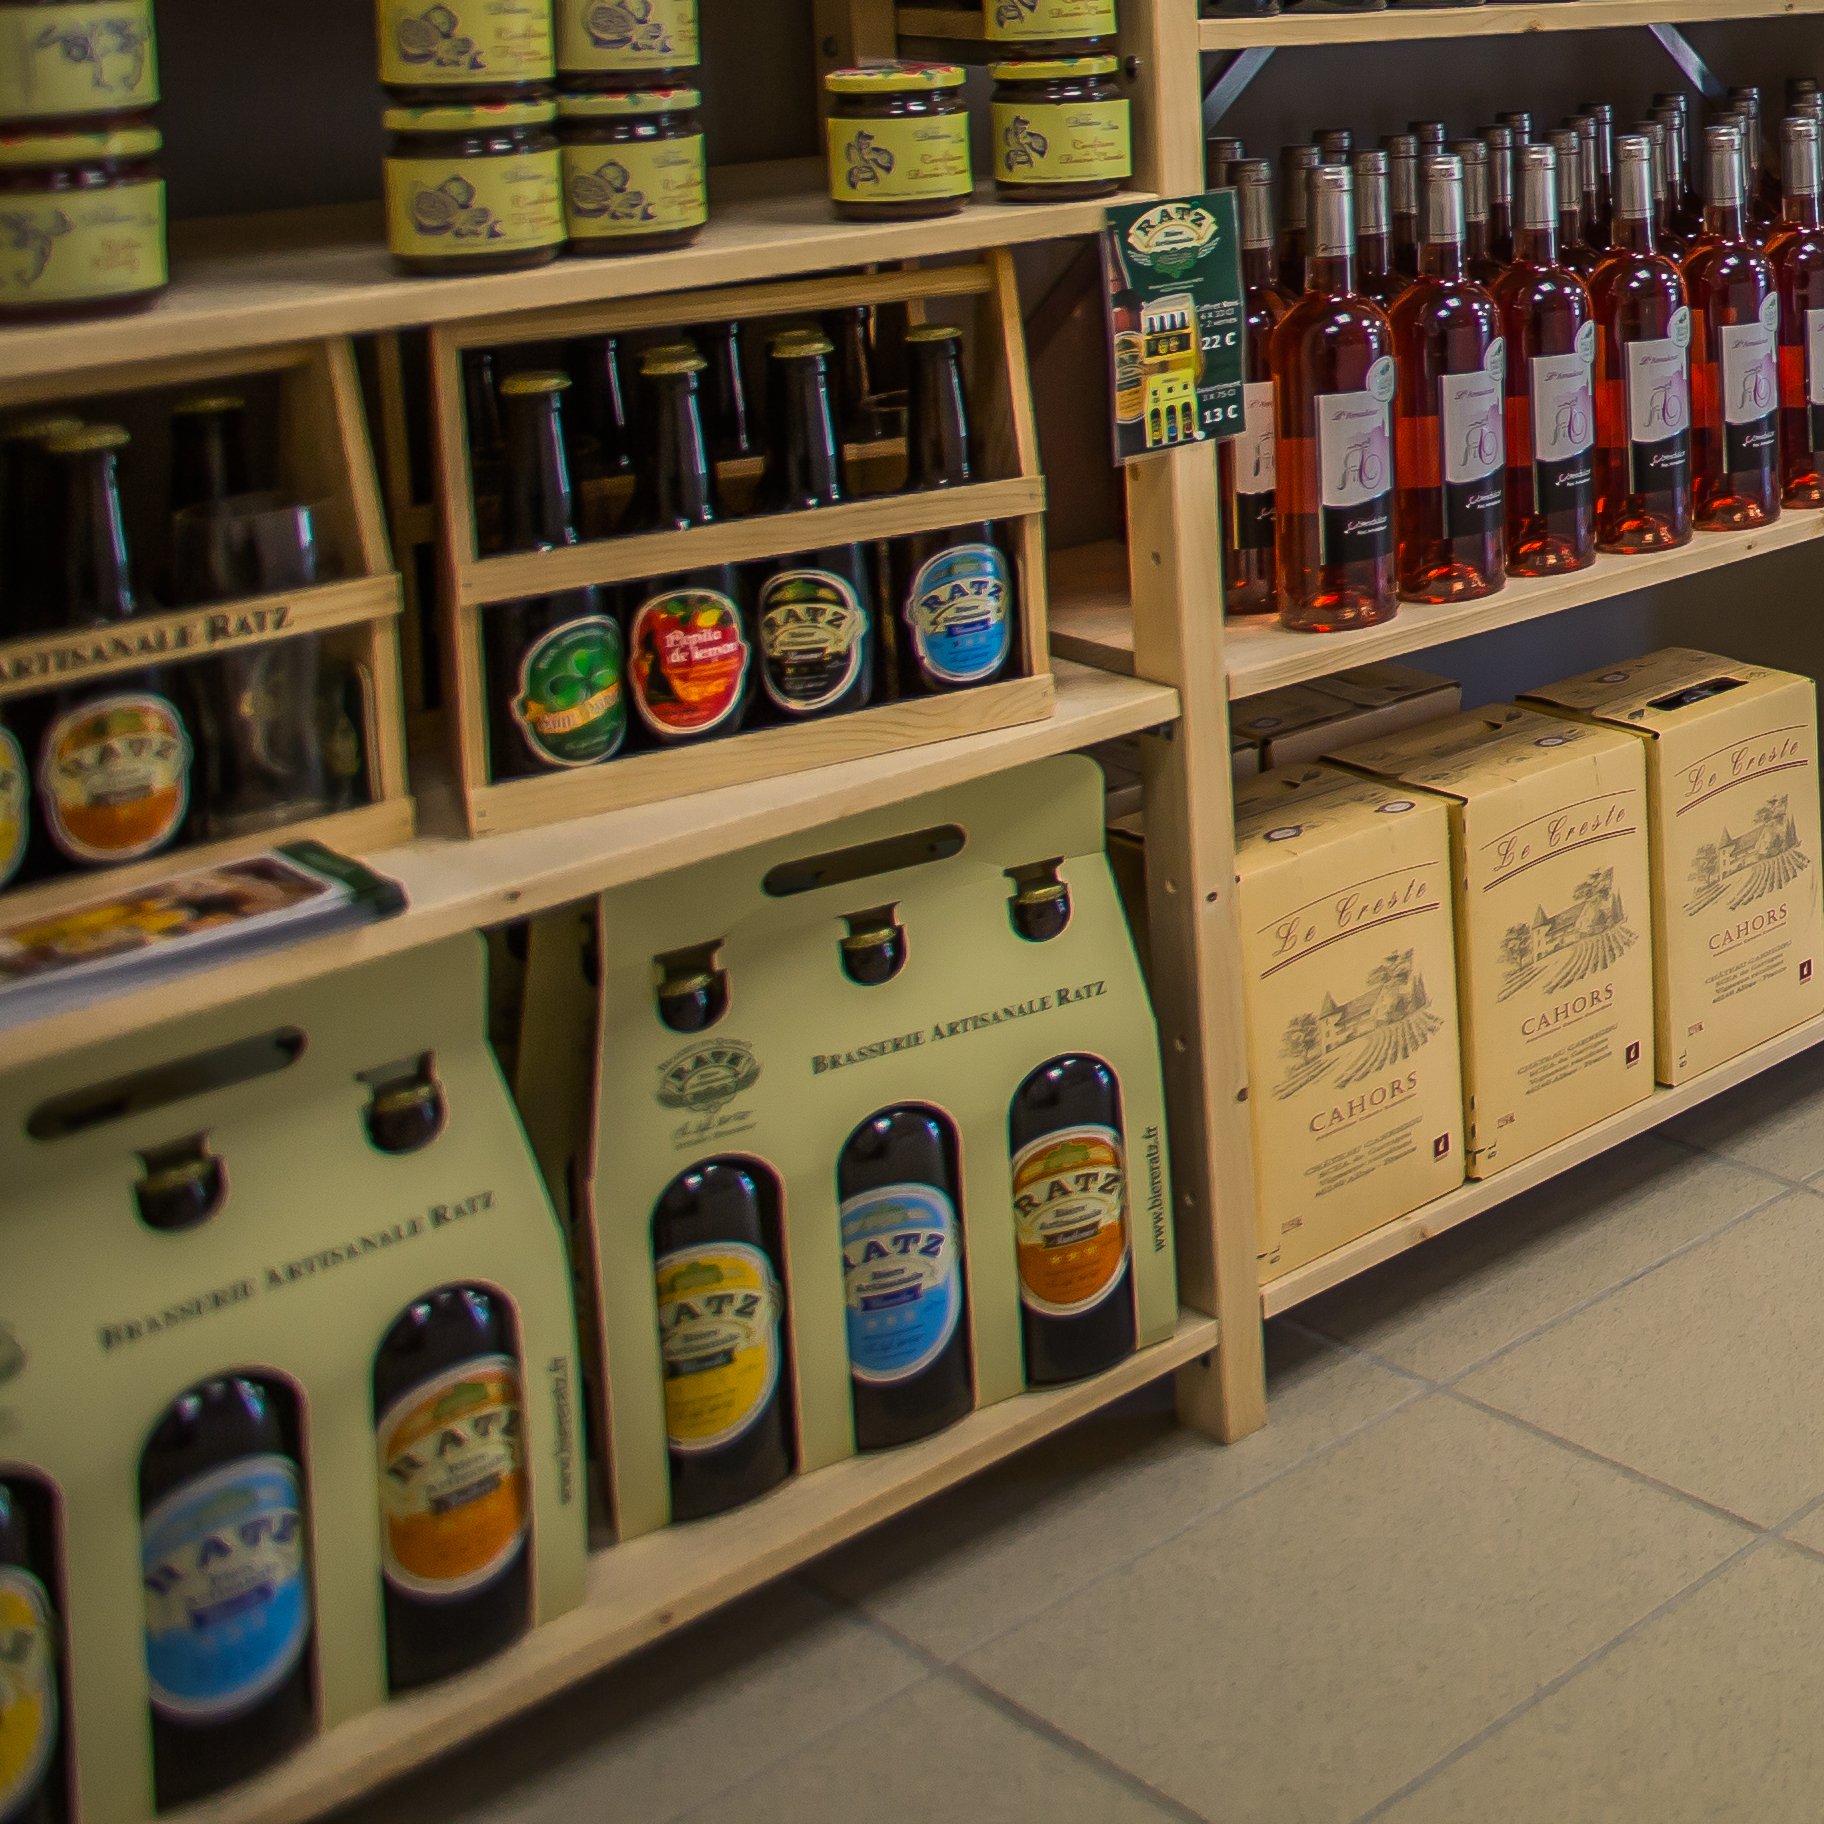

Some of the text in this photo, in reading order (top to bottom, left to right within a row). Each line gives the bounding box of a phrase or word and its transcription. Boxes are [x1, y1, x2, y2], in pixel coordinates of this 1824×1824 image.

[1136, 205, 1208, 237] RATZ
[1201, 331, 1237, 351] 22 €
[1203, 404, 1238, 424] 13 €
[920, 578, 1004, 616] RATZ
[206, 606, 293, 644] RATZ
[60, 737, 178, 774] RATZ
[1685, 737, 1800, 798] Le Creste
[1492, 804, 1626, 872] Le Creste
[1272, 878, 1428, 957] Le Creste
[1707, 902, 1789, 952] CAHORS
[810, 980, 1108, 1075] BRASSERIE ARTISANALE RATZ
[1520, 982, 1616, 1037] CAHORS
[1309, 1070, 1420, 1133] CAHORS
[1014, 1172, 1122, 1217] RATZ
[1141, 1125, 1168, 1254] www.biereratz.fr
[100, 1190, 497, 1354] BRASSERIE ARTISANALE RATZ
[843, 1232, 946, 1271] ATZ
[387, 1408, 521, 1482] RATZ
[144, 1512, 301, 1597] RATZ
